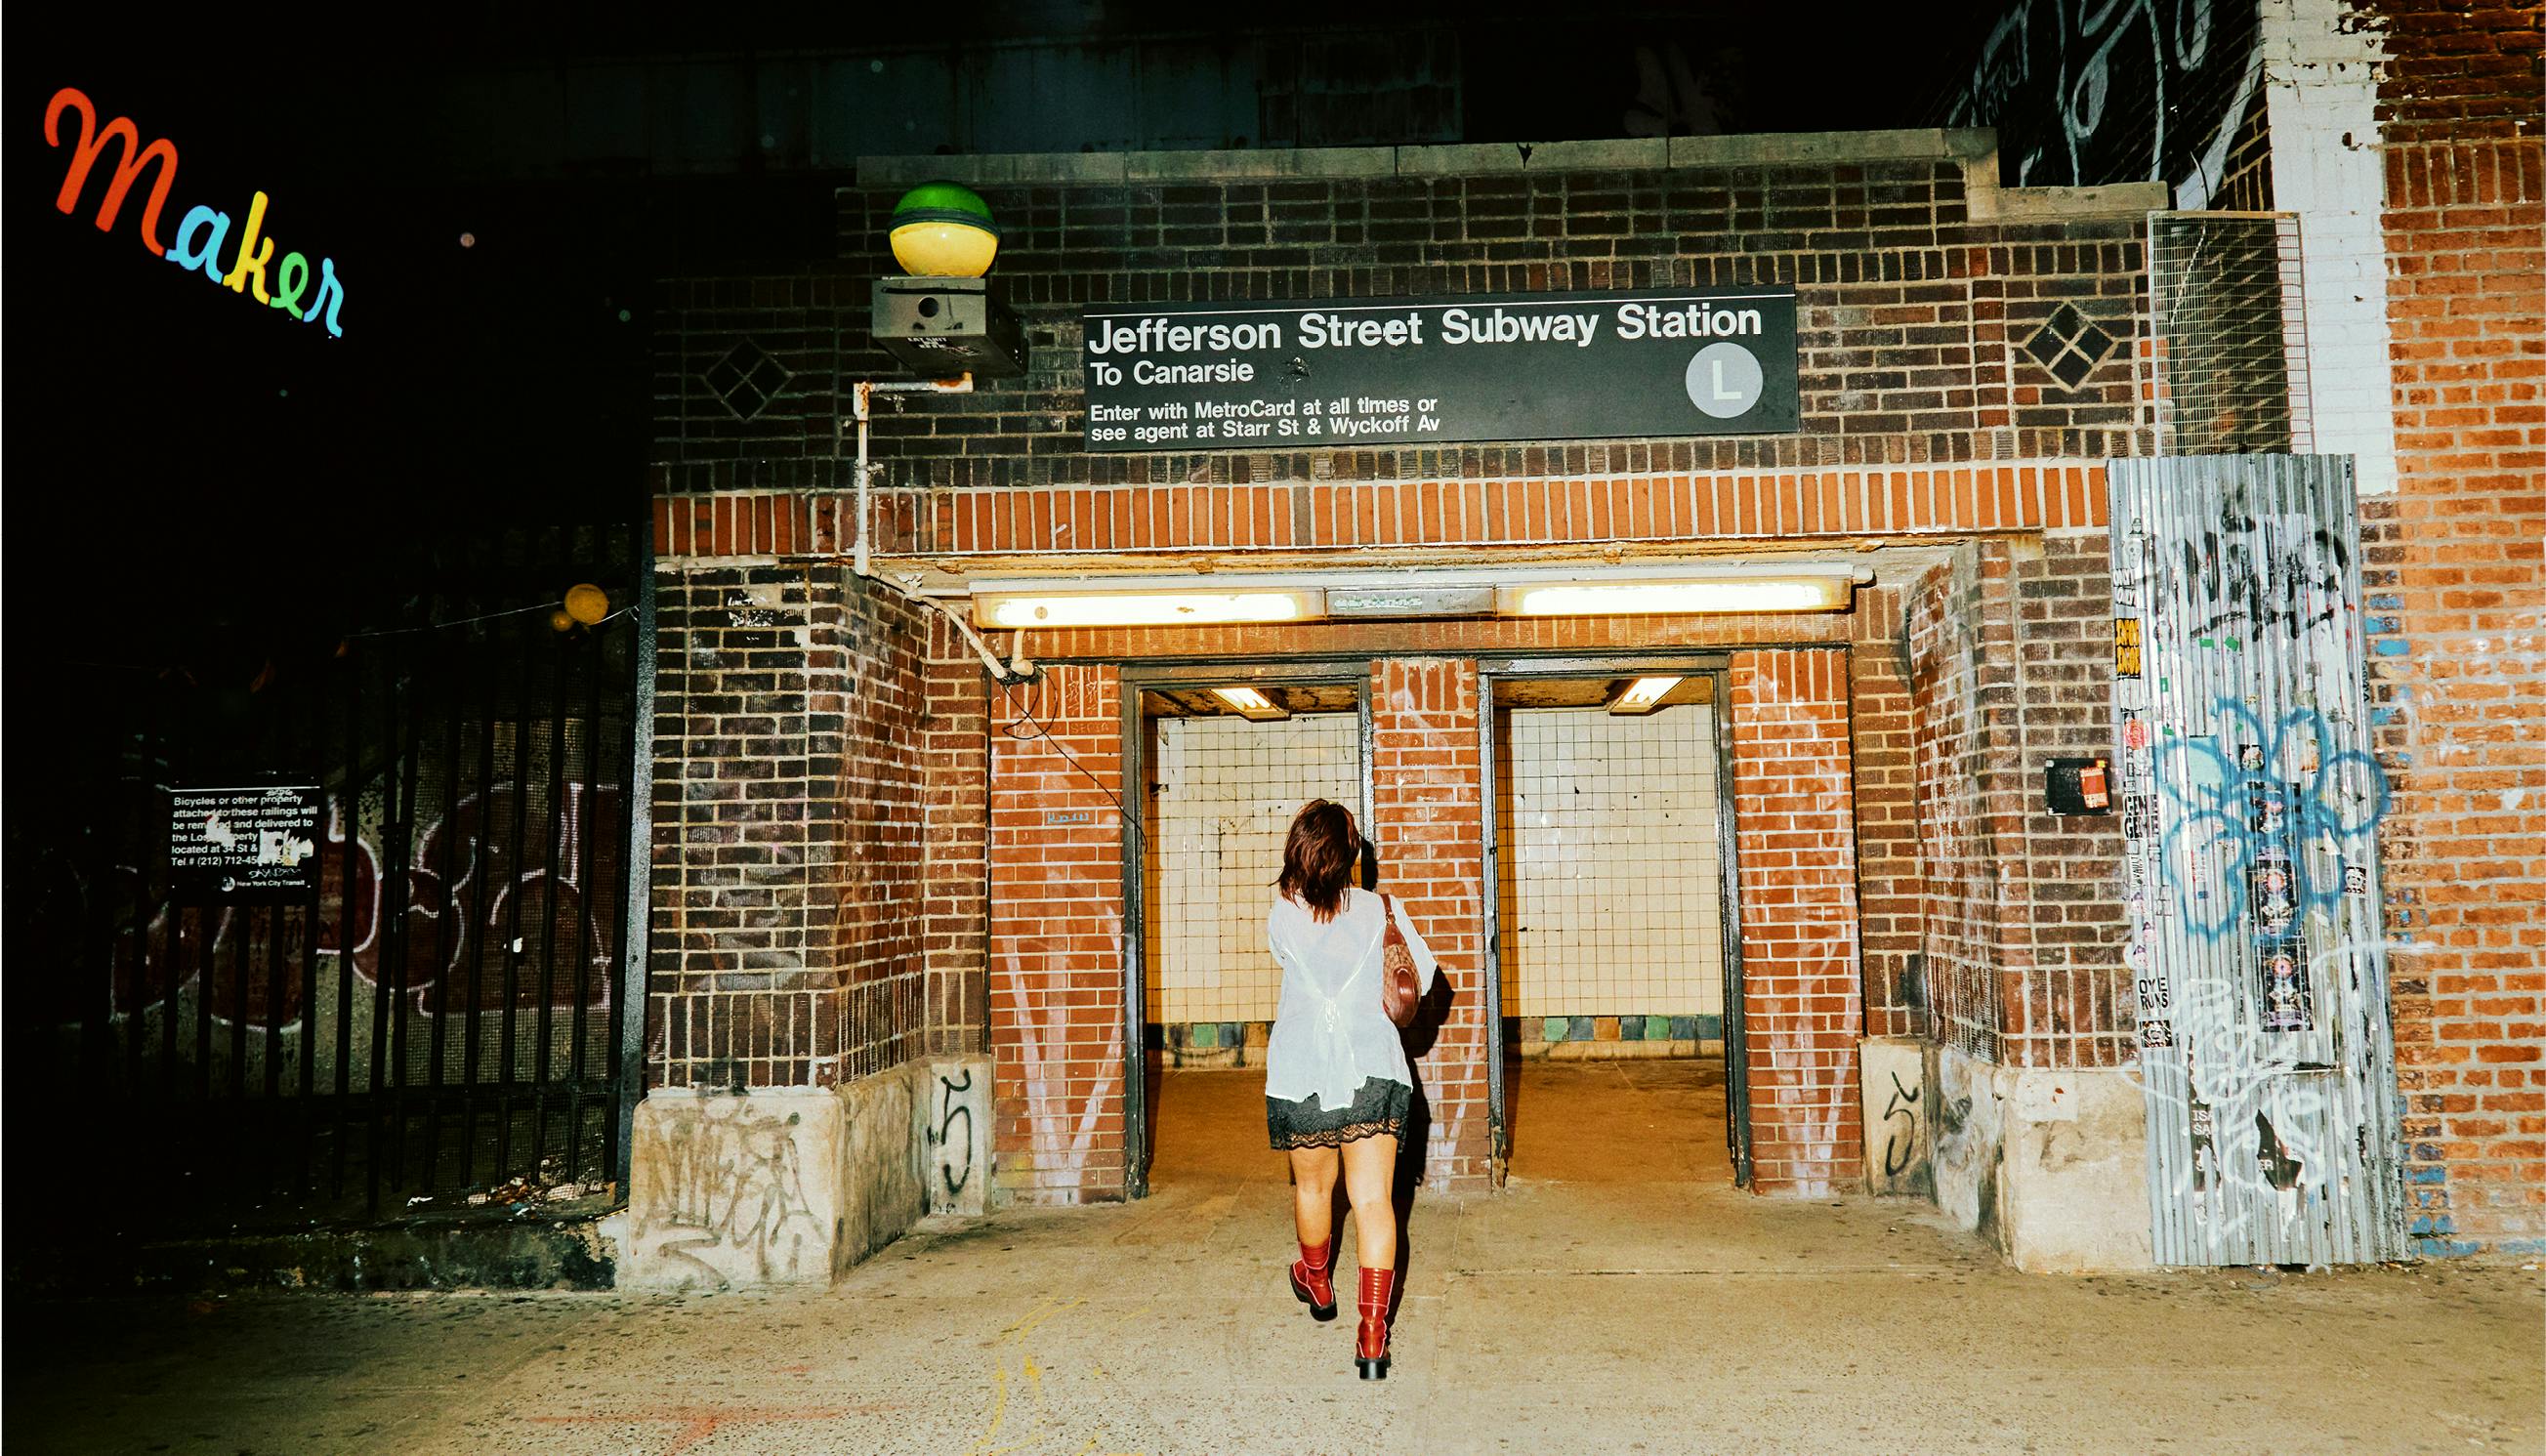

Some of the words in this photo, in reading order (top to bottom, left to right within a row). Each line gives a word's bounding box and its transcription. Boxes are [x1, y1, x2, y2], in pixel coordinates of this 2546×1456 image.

[44, 87, 344, 337] Maker
[1090, 318, 1280, 354] Jefferson
[1299, 312, 1423, 348] Street
[1442, 309, 1599, 347] Subway
[1617, 303, 1761, 339] Station
[1091, 362, 1121, 385] To
[1134, 358, 1254, 385] Canarsie
[1713, 360, 1742, 399] L
[1091, 405, 1141, 421] Enter
[1148, 402, 1187, 419] with
[1195, 399, 1295, 420] MetroCard
[1303, 400, 1321, 415] at
[1329, 398, 1350, 414] all
[1357, 397, 1409, 413] times
[1418, 398, 1438, 412] or
[1092, 429, 1126, 440] see
[1135, 424, 1188, 442] agent
[1196, 423, 1215, 437] at
[1223, 421, 1271, 437] Starr
[1278, 419, 1299, 436] St
[1308, 419, 1321, 435] &
[1329, 417, 1409, 437] Wyckoff
[1417, 415, 1440, 432] Av
[174, 796, 216, 808] Bicycles
[232, 796, 258, 805] other
[261, 795, 303, 806] property
[173, 809, 216, 818] attached
[230, 808, 258, 816] these
[261, 807, 298, 817] railings
[301, 806, 317, 814] will
[188, 820, 230, 830] remed
[255, 818, 301, 828] delivered
[303, 818, 313, 827] to
[172, 833, 188, 842] the
[171, 845, 208, 853] located
[237, 844, 248, 853] St
[250, 844, 258, 853] &
[197, 856, 222, 867] (212)
